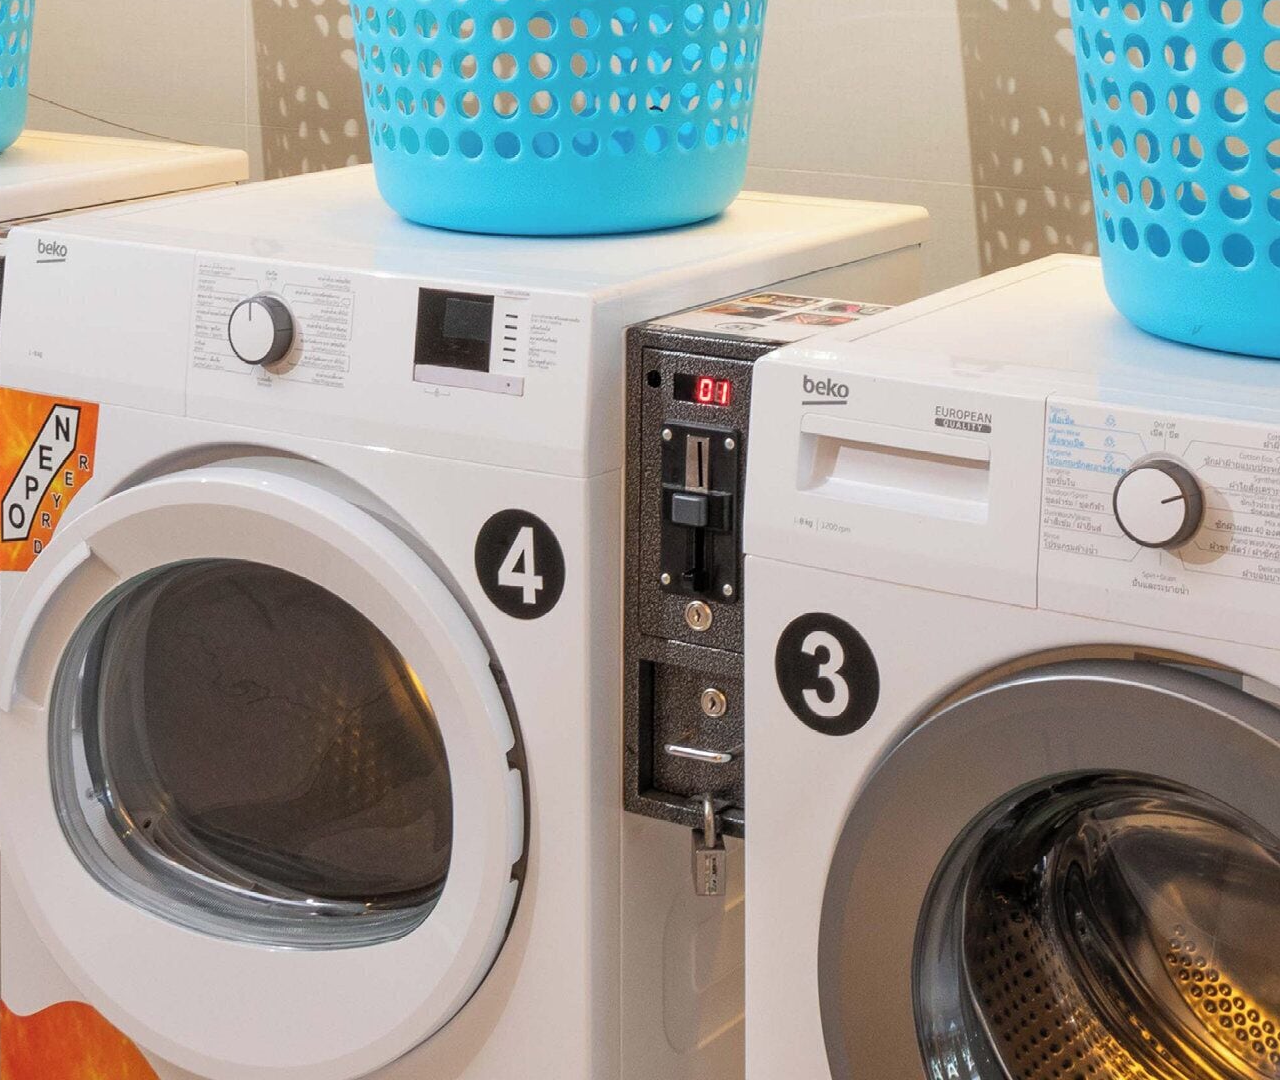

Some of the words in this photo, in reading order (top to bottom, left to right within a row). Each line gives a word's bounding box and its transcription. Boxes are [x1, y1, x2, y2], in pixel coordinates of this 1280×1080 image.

[37, 238, 68, 257] beko
[699, 378, 729, 405] 01
[803, 375, 850, 398] beko
[935, 406, 992, 424] EUROPEAN
[943, 419, 983, 432] QUALITY
[8, 415, 70, 529] OPEN
[33, 455, 89, 554] DRYER
[498, 526, 544, 605] 4
[800, 629, 849, 719] 3
